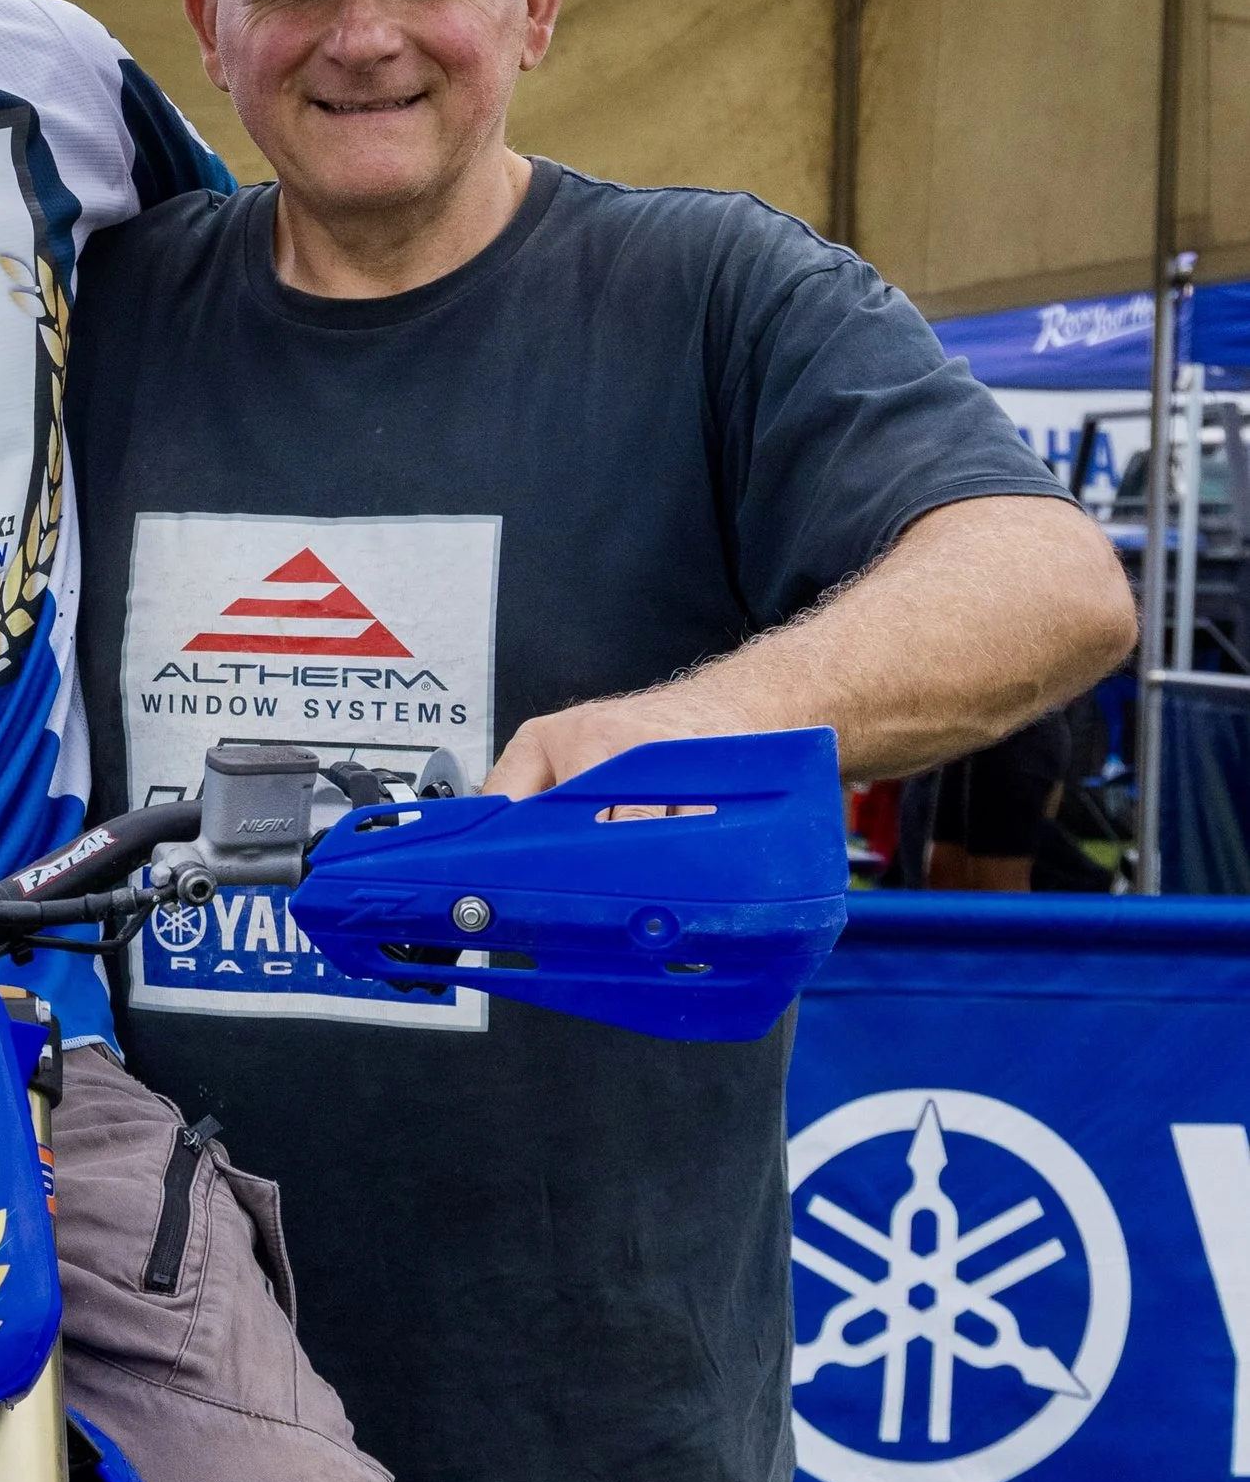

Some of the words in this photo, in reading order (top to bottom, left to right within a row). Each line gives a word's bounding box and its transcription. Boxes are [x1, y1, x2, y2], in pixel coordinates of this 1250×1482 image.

[152, 662, 449, 691] ALTHERM
[141, 693, 278, 717] WINDOW
[303, 698, 468, 724] SYSTEMS
[13, 827, 117, 893] FATBAR
